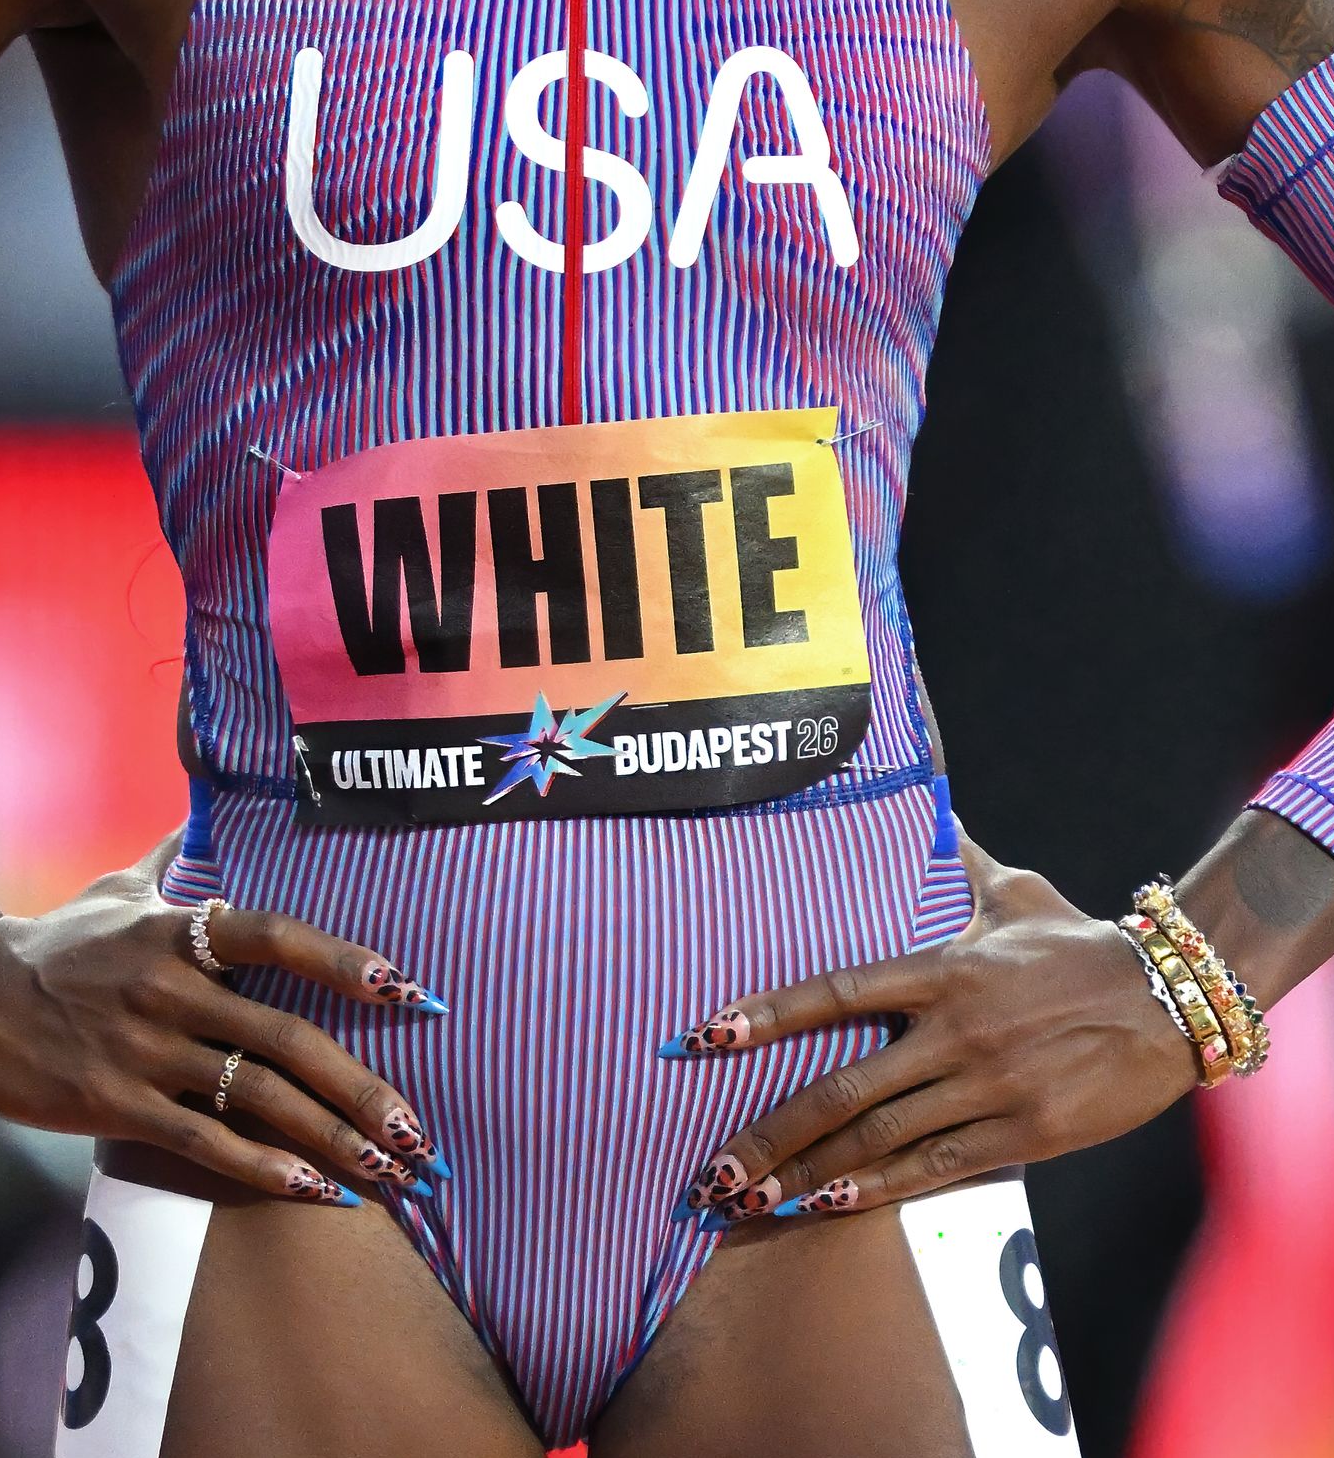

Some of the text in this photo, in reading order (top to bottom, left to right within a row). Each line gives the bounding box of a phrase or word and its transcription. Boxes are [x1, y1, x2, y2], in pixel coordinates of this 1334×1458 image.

[285, 45, 861, 274] USA
[320, 461, 810, 677] WHITE
[331, 716, 840, 790] ULTIMATE BUDAPEST 26
[63, 1217, 120, 1430] 8
[999, 1228, 1072, 1437] 8
